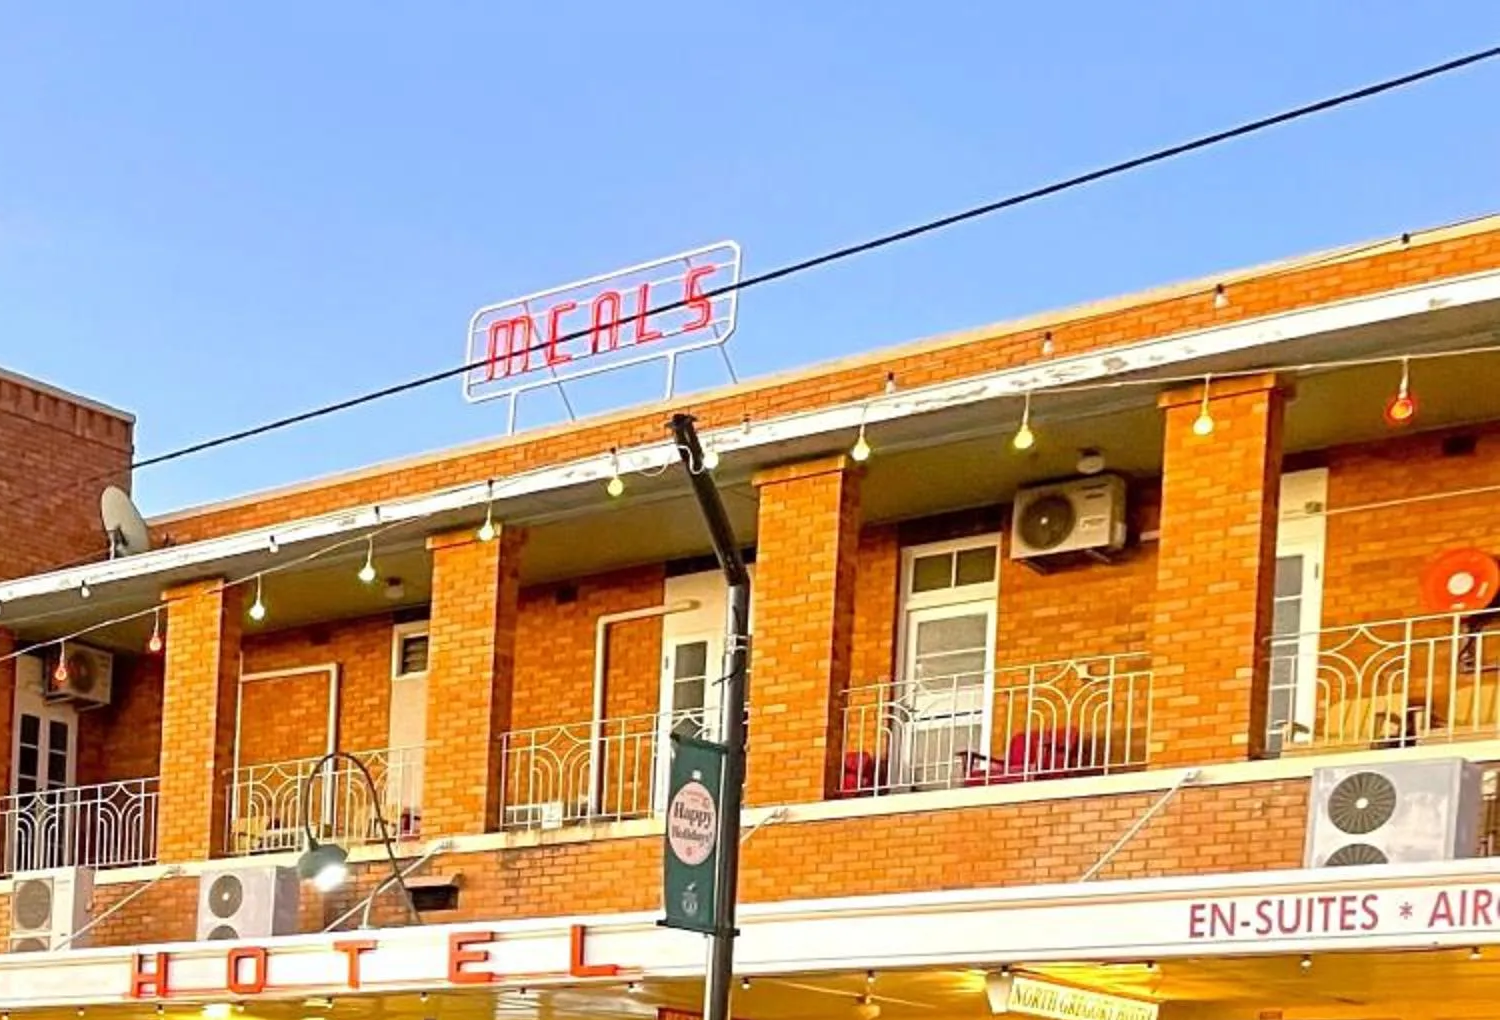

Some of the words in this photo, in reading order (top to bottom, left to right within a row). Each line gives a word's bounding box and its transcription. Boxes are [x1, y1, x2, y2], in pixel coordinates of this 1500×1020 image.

[486, 265, 715, 382] MEALS
[674, 802, 713, 829] Happy
[1188, 893, 1380, 939] EN-SUITES
[1427, 888, 1500, 929] AIR
[130, 923, 619, 998] HOTEL
